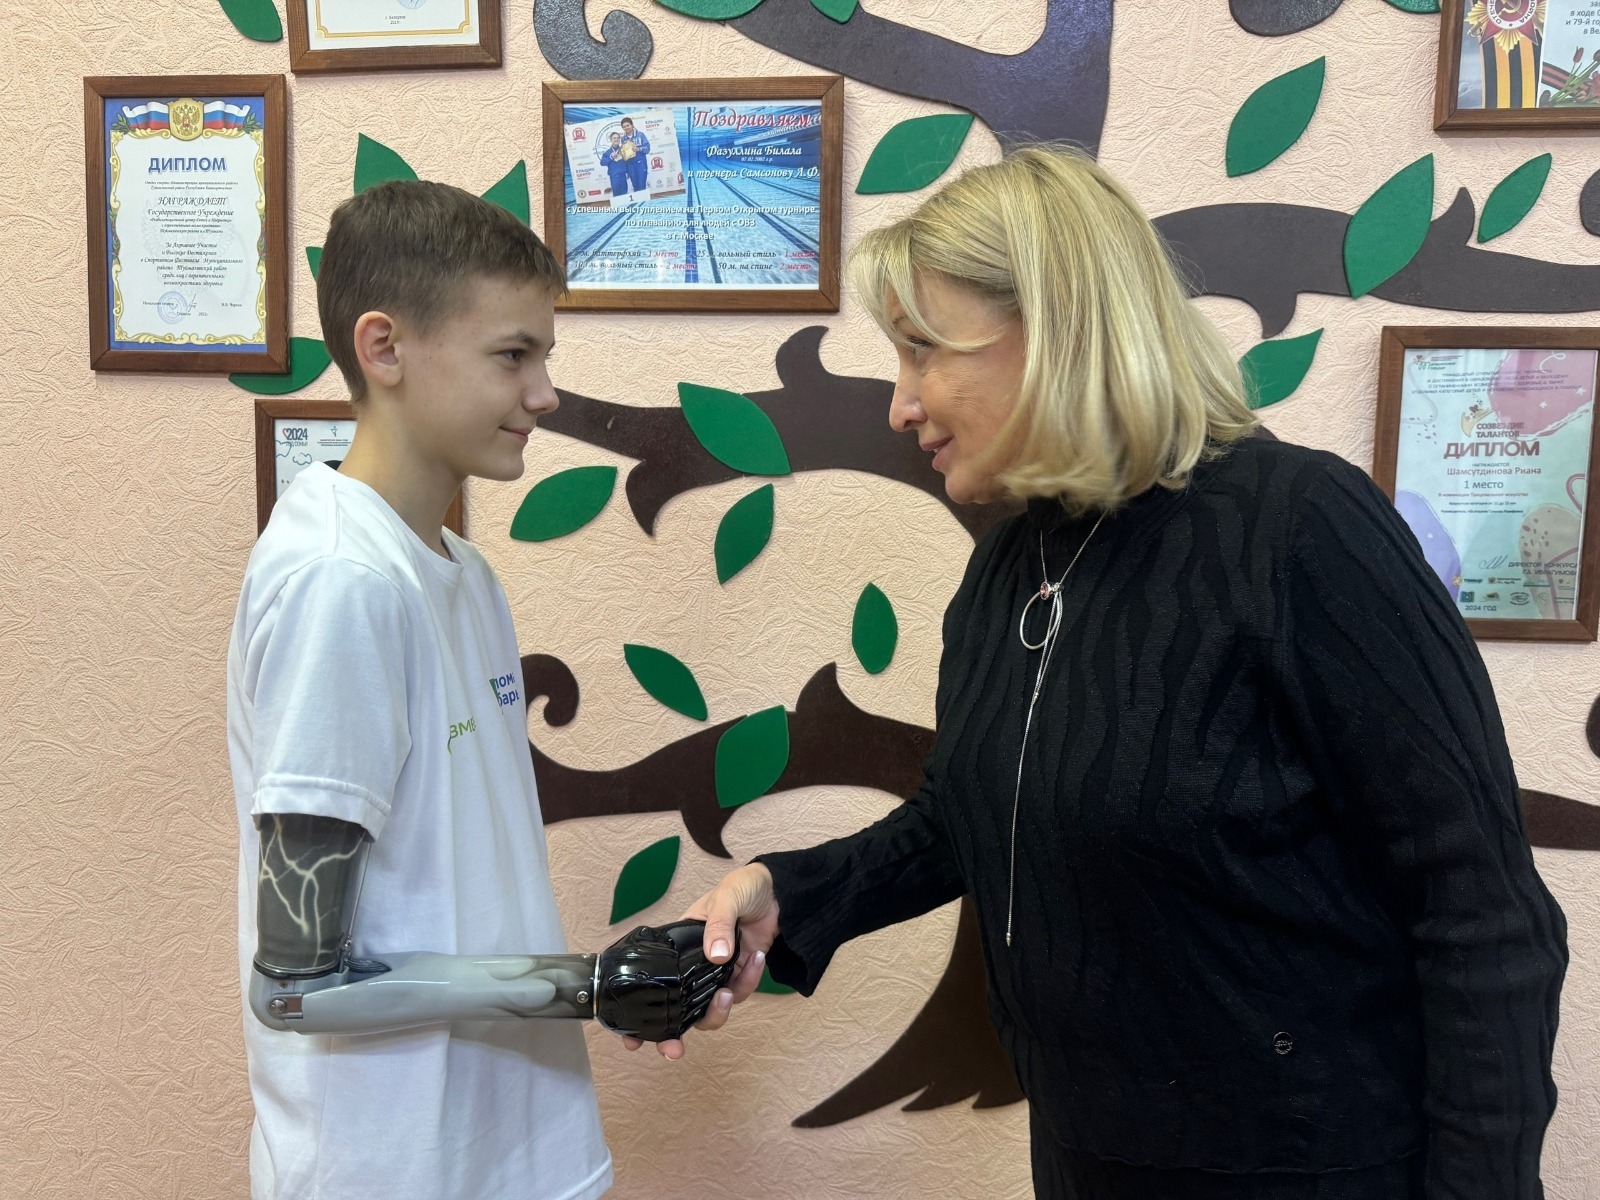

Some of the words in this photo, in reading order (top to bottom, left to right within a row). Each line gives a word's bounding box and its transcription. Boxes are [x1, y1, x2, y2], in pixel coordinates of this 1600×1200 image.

[692, 108, 810, 132] Поздравляем
[706, 145, 762, 158] Фазуллина
[764, 146, 802, 155] Билала
[148, 158, 227, 174] ДИПЛОМ
[696, 170, 737, 179] тренера
[740, 168, 793, 179] Самсонову
[158, 197, 228, 206] НАГРАЖДАЕТ
[148, 209, 196, 218] Государственное
[197, 209, 234, 217] Учреждение
[572, 206, 618, 215] успешным
[620, 206, 684, 215] выступлением
[697, 206, 731, 215] Первом
[732, 206, 779, 215] Открытом
[781, 206, 816, 215] турнире
[700, 219, 730, 228] людей
[737, 219, 756, 227] ОВЗ
[592, 250, 641, 259] баттерфляй
[286, 428, 308, 440] 2024
[1443, 441, 1540, 459] ДИПЛОМ
[1447, 468, 1512, 476] Шамсутдинова
[1464, 480, 1469, 489] 1
